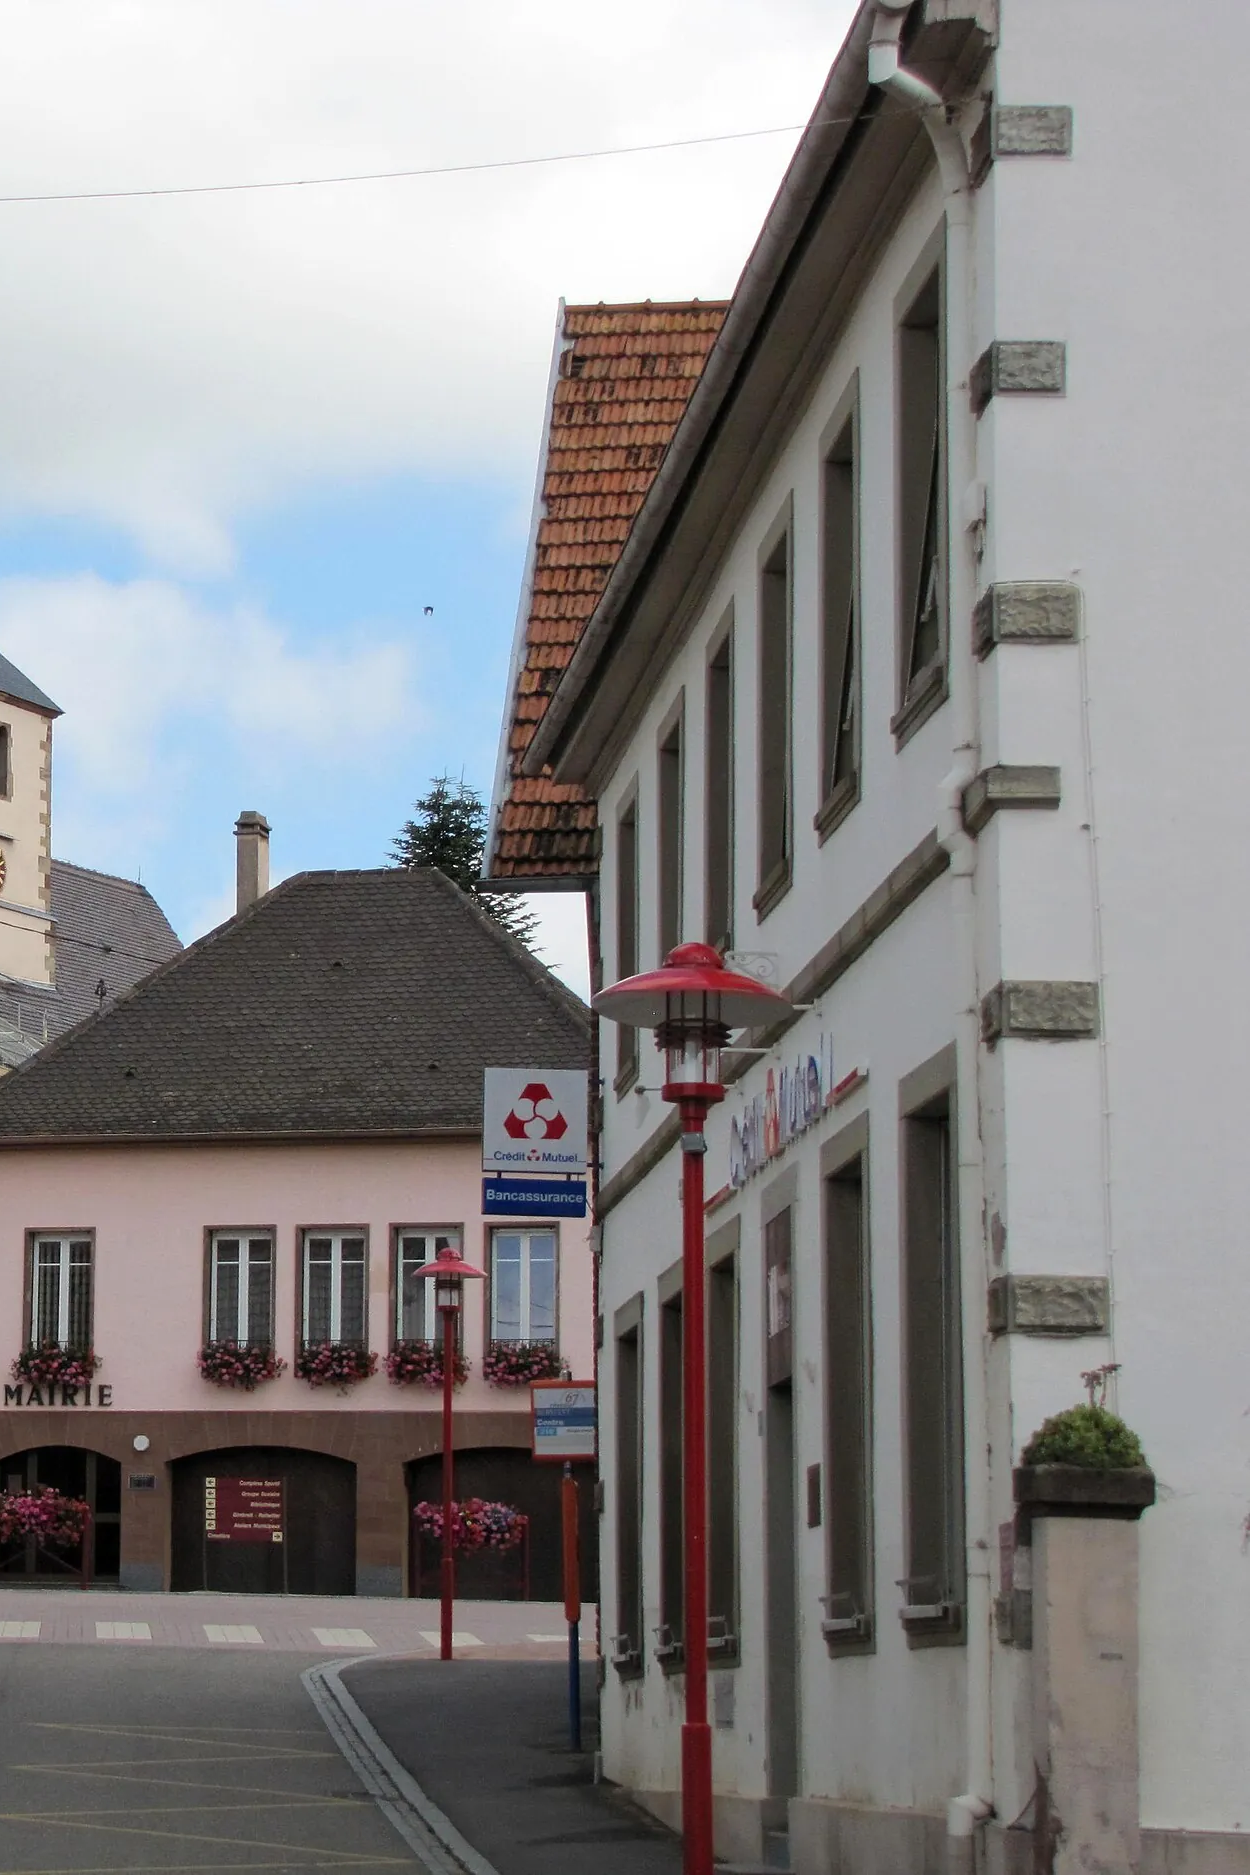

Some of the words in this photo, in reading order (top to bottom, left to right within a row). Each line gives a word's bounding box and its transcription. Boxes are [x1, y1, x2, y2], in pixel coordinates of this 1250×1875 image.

[493, 1151, 526, 1161] Crédit
[541, 1153, 578, 1163] Mutuel
[486, 1188, 584, 1203] Bancassurance
[4, 1384, 113, 1407] MAIRIE
